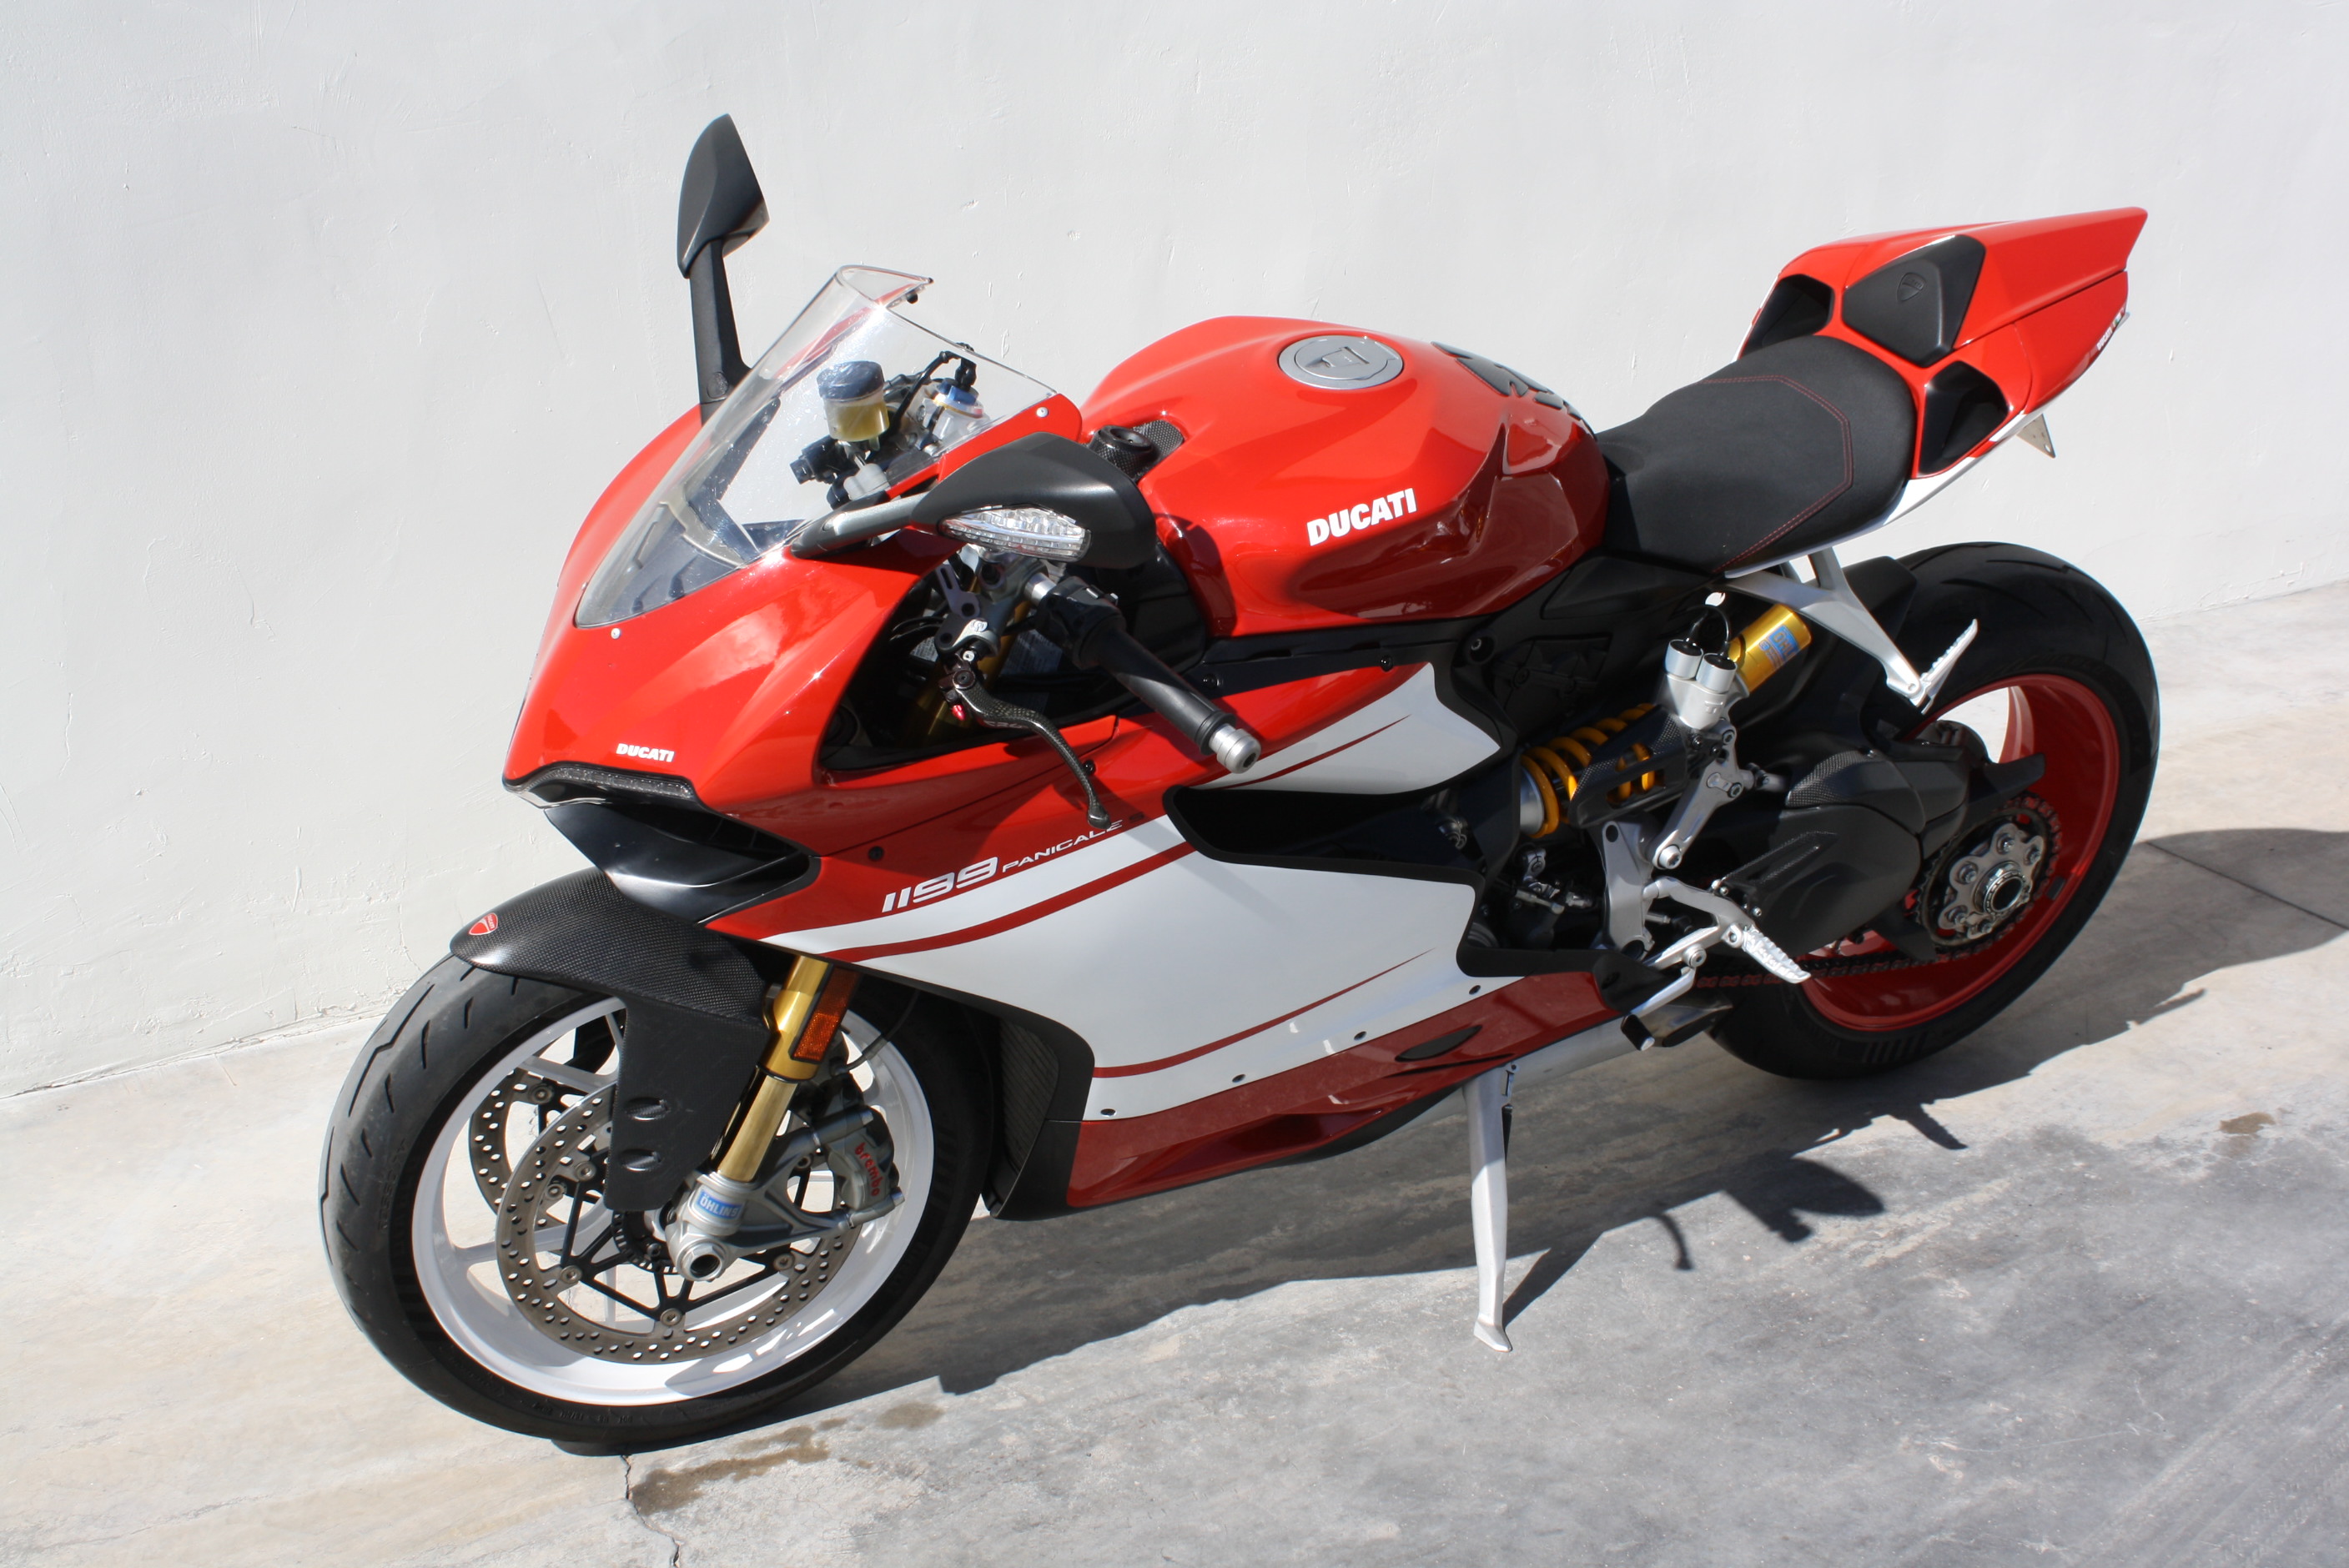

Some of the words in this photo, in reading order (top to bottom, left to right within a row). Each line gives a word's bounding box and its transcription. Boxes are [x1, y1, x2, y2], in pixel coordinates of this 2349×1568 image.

[1306, 488, 1417, 546] DUCATI
[616, 743, 675, 763] DUCATI
[882, 857, 998, 913] 1199
[1002, 819, 1123, 873] PANIGALE
[854, 1142, 883, 1197] brembo
[700, 1193, 739, 1217] ÖHLINS
